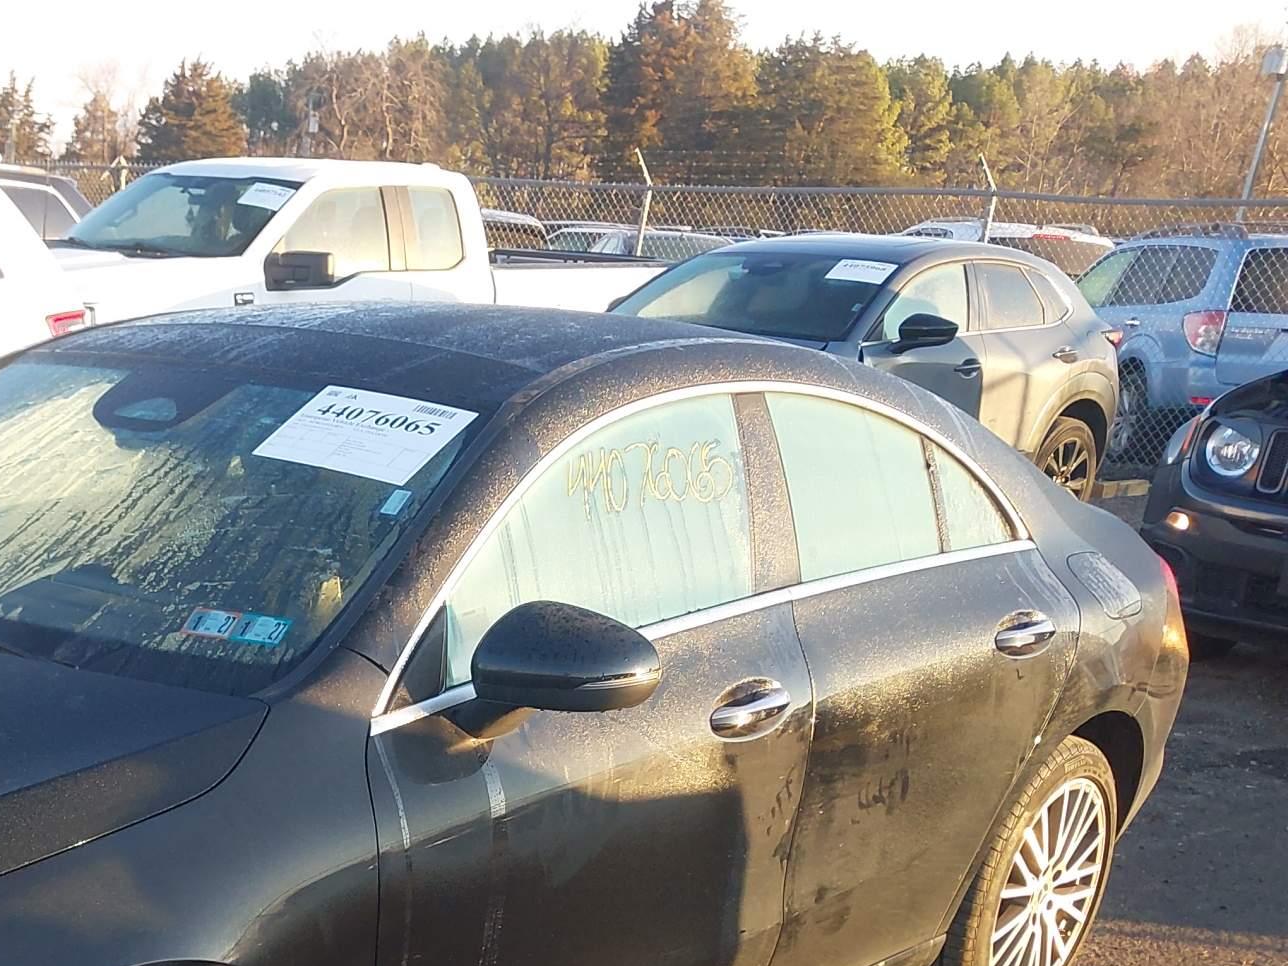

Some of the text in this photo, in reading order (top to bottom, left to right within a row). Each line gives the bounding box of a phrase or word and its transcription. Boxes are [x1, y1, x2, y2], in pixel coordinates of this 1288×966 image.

[317, 403, 443, 436] 44076065
[566, 438, 734, 516] 44076065
[217, 615, 237, 635] 27
[268, 622, 288, 641] 27
